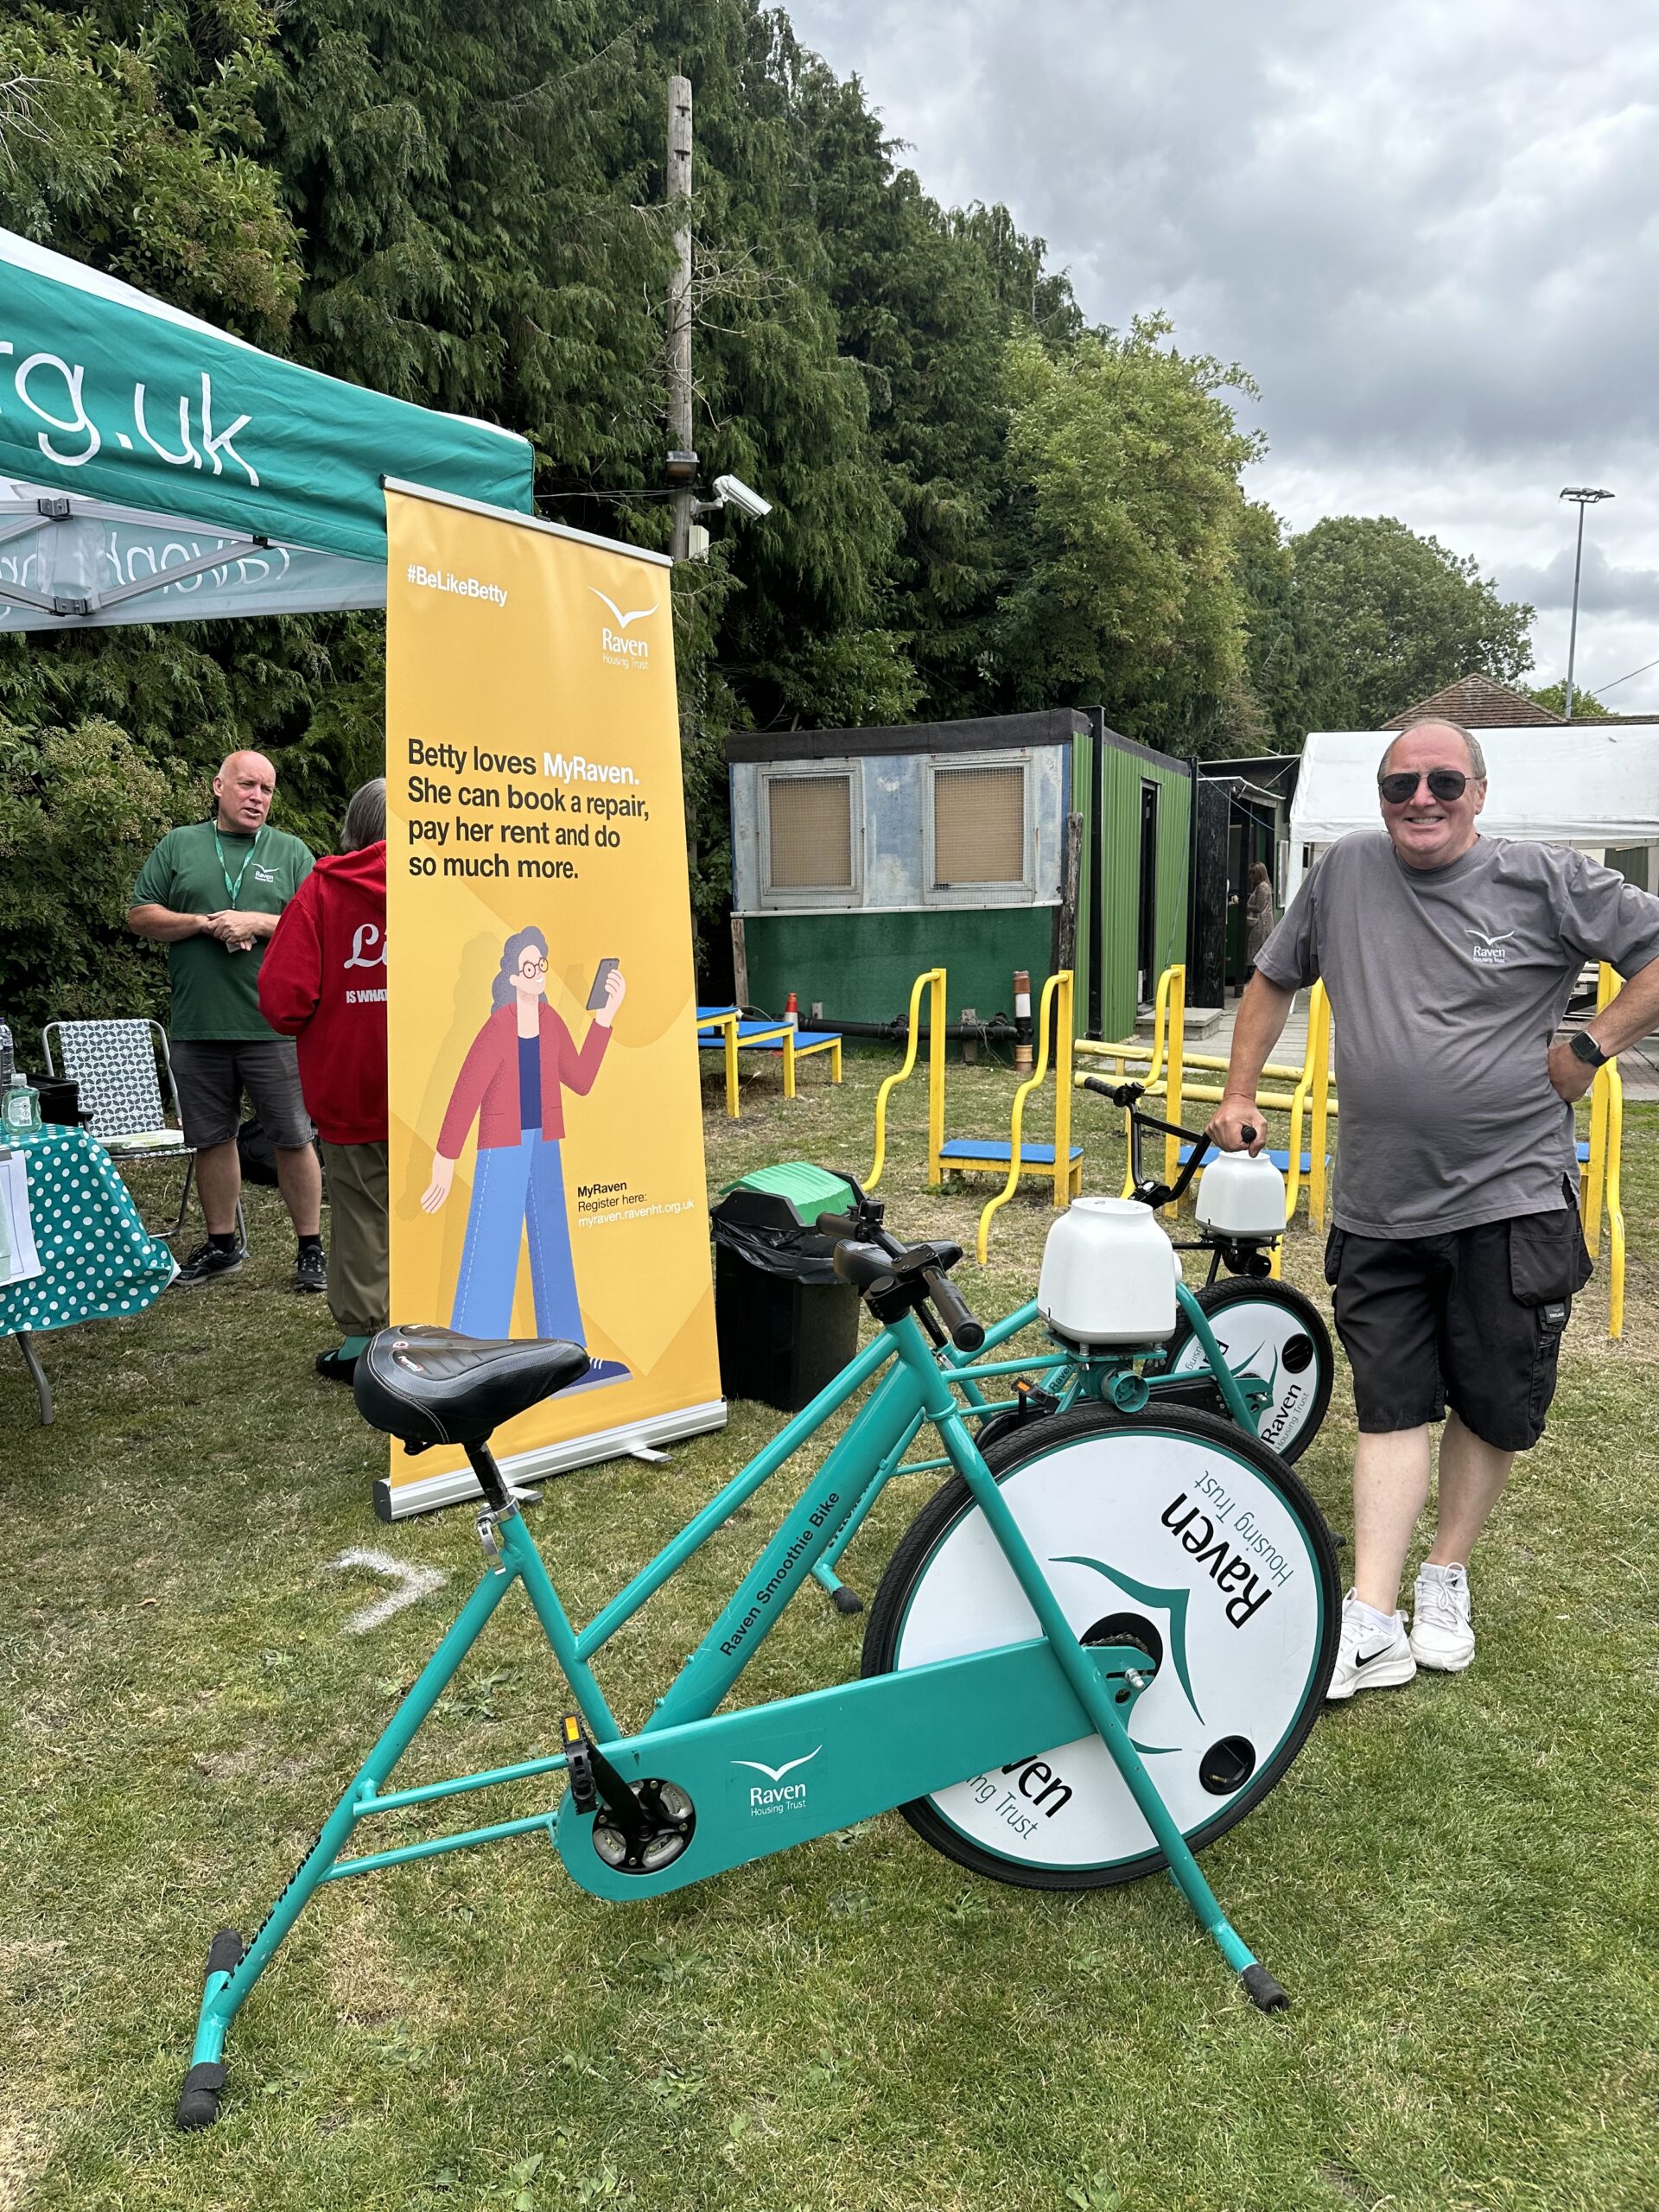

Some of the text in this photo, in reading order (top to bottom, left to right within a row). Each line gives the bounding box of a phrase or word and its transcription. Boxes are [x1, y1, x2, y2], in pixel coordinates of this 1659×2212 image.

[0, 341, 259, 486] g.uk
[407, 564, 508, 607] #BeLikeBetty
[602, 627, 648, 658] Raven
[602, 653, 649, 671] Housing Trust
[408, 738, 640, 785] Betty loves MyRaven.
[408, 776, 649, 821] She can book a repair,
[409, 817, 620, 848] pay her rent and do
[409, 854, 579, 879] so much more.
[1473, 946, 1505, 957] Raven
[346, 990, 357, 1003] IS
[577, 1182, 627, 1198] MyRaven
[578, 1193, 648, 1212] Register here:
[578, 1198, 694, 1227] myraven.ravenht.org.uk
[1261, 1383, 1302, 1445] Raven
[1275, 1392, 1310, 1451] Housing Trust
[1194, 1470, 1294, 1587] Housing Trust
[719, 1492, 840, 1656] Raven Smoothie Bike
[1160, 1492, 1273, 1630] Raven
[750, 1783, 806, 1807] Raven
[1001, 1755, 1073, 1818] ven
[751, 1799, 807, 1817] Housing Trust
[995, 1791, 1039, 1840] Trust
